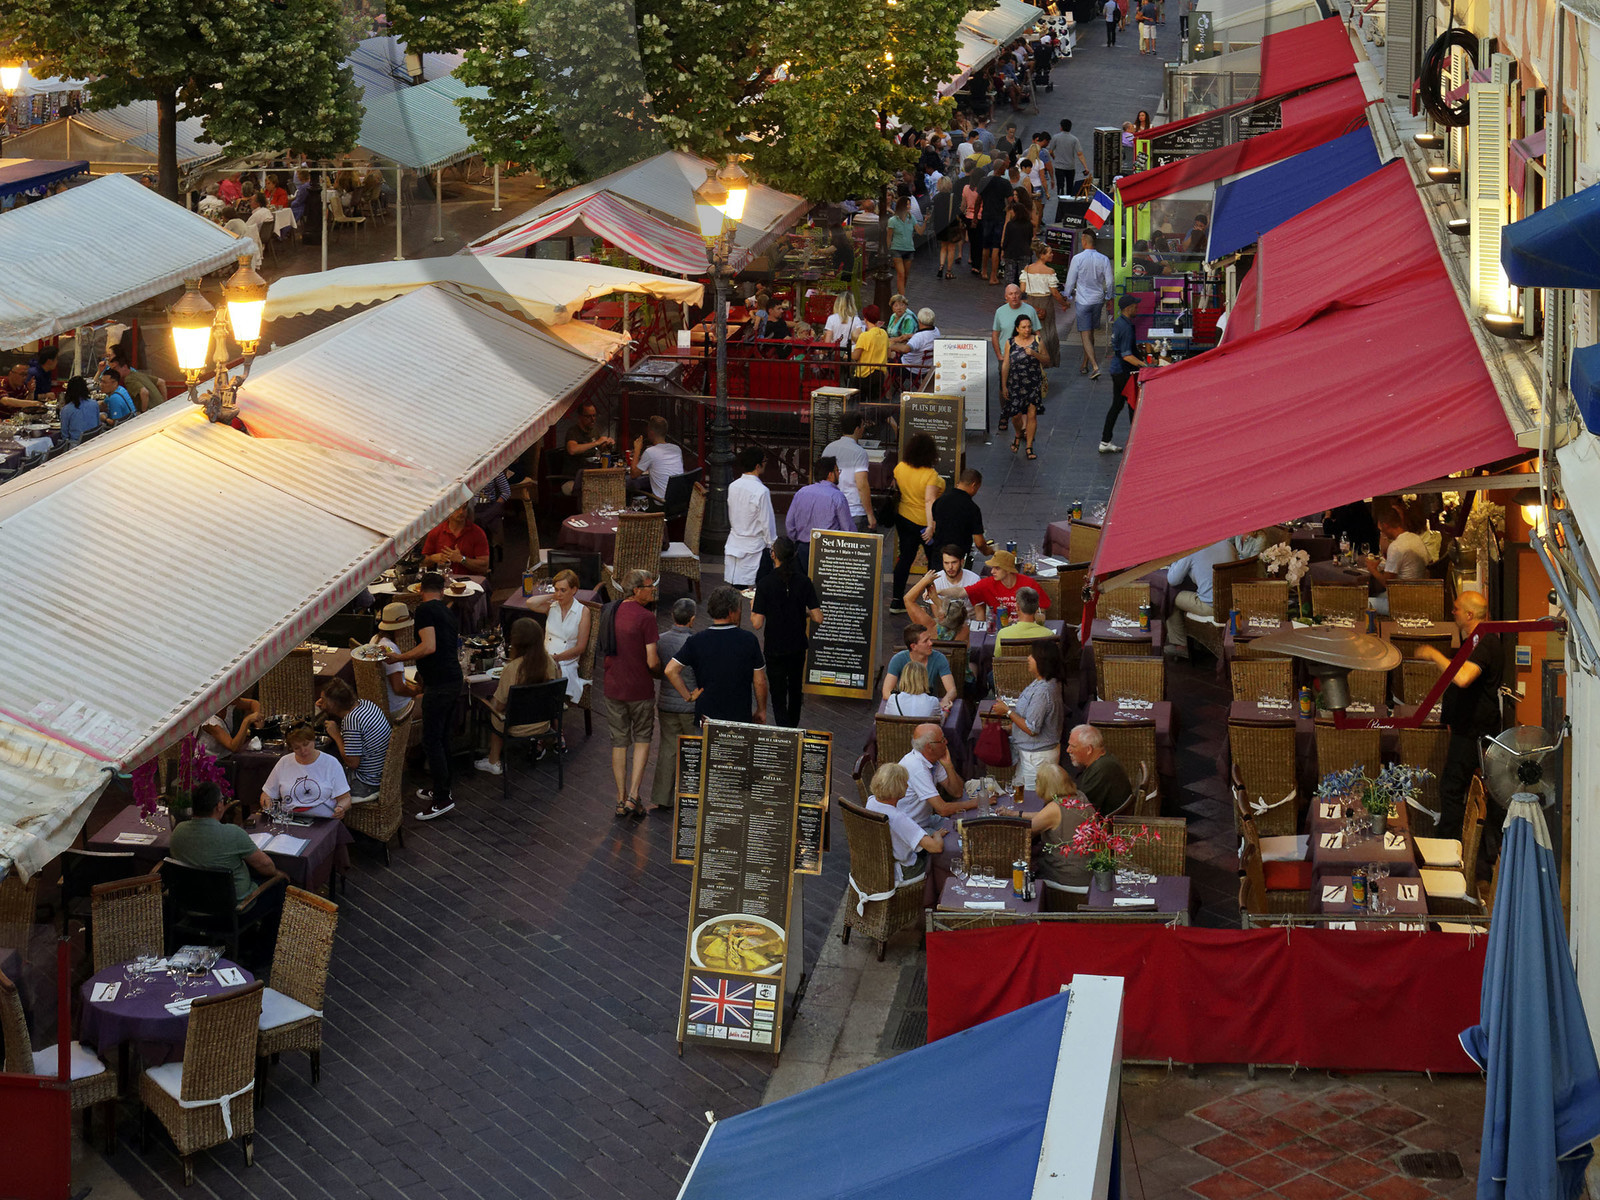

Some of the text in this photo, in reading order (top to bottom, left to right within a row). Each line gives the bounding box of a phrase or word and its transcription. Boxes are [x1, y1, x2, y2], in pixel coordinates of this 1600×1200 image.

[912, 404, 929, 412] PLATS
[822, 538, 835, 547] Set
[836, 539, 858, 549] Menu
